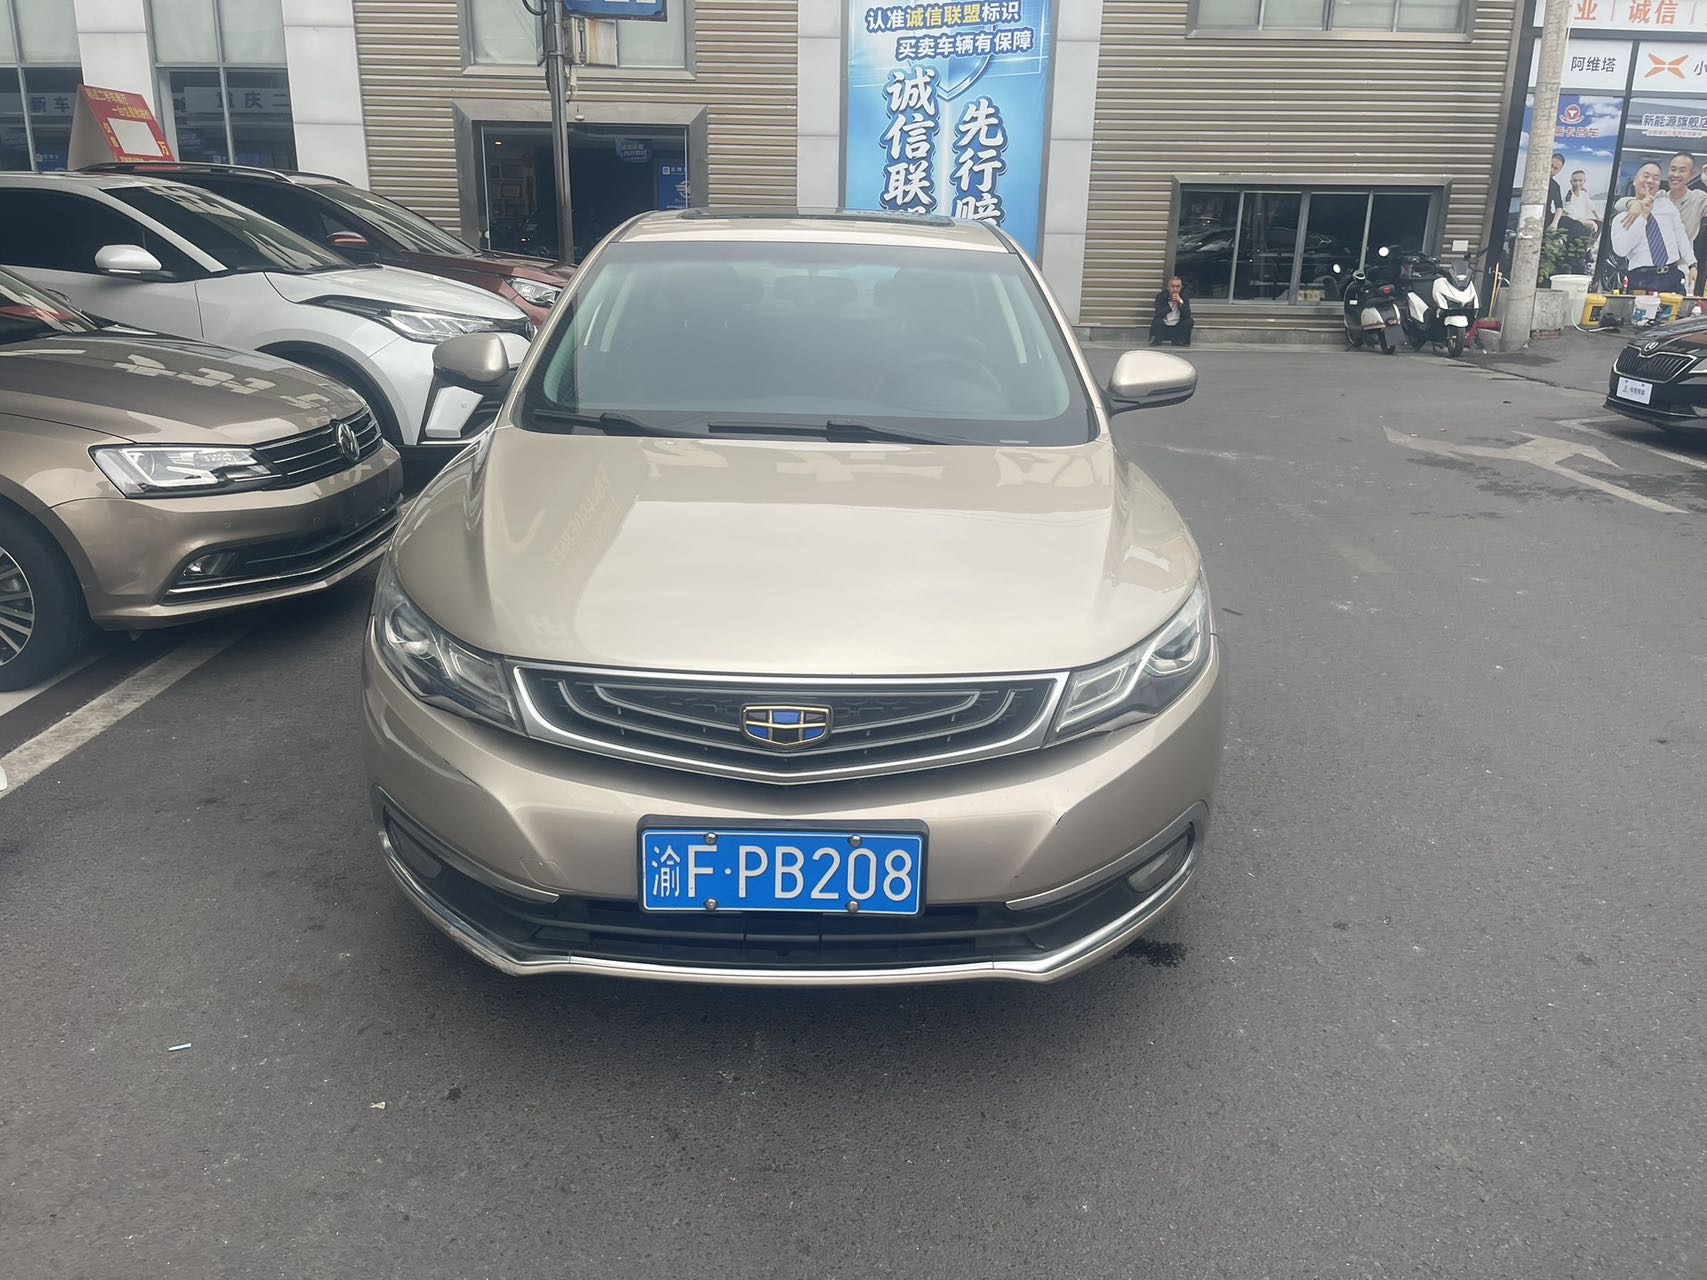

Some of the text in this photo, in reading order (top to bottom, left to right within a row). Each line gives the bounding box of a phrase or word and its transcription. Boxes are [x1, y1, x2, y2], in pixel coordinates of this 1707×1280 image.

[867, 2, 1020, 31] 认准诚信联盟标识
[1628, 0, 1679, 24] 诚信
[898, 32, 1033, 58] 买卖车辆有保障
[1571, 57, 1616, 73] 阿维塔
[1693, 60, 1707, 76] 小
[883, 66, 937, 213] 诚信联
[651, 843, 913, 902] 渝F·PB208
